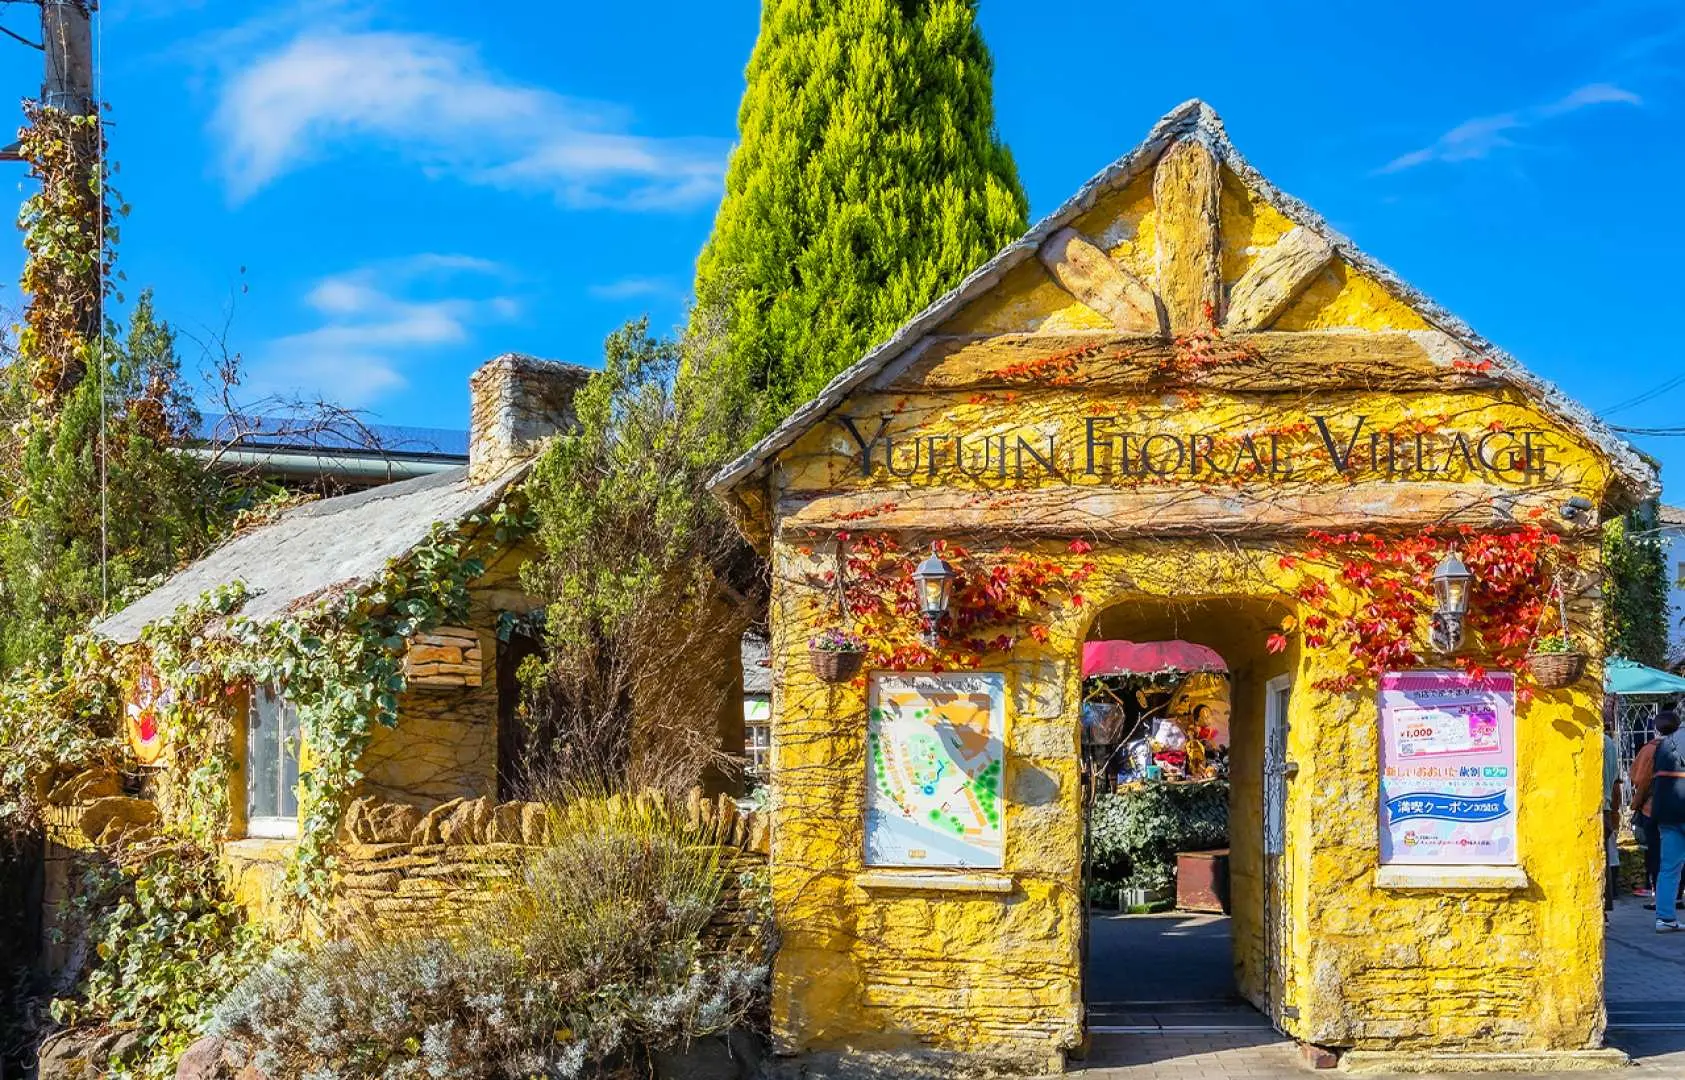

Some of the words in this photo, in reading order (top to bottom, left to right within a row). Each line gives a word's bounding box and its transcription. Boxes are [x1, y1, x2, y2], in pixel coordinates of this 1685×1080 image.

[839, 416, 1060, 476] YUFUIN
[1084, 416, 1294, 476] FLORAL
[1310, 415, 1546, 473] VILLAGE
